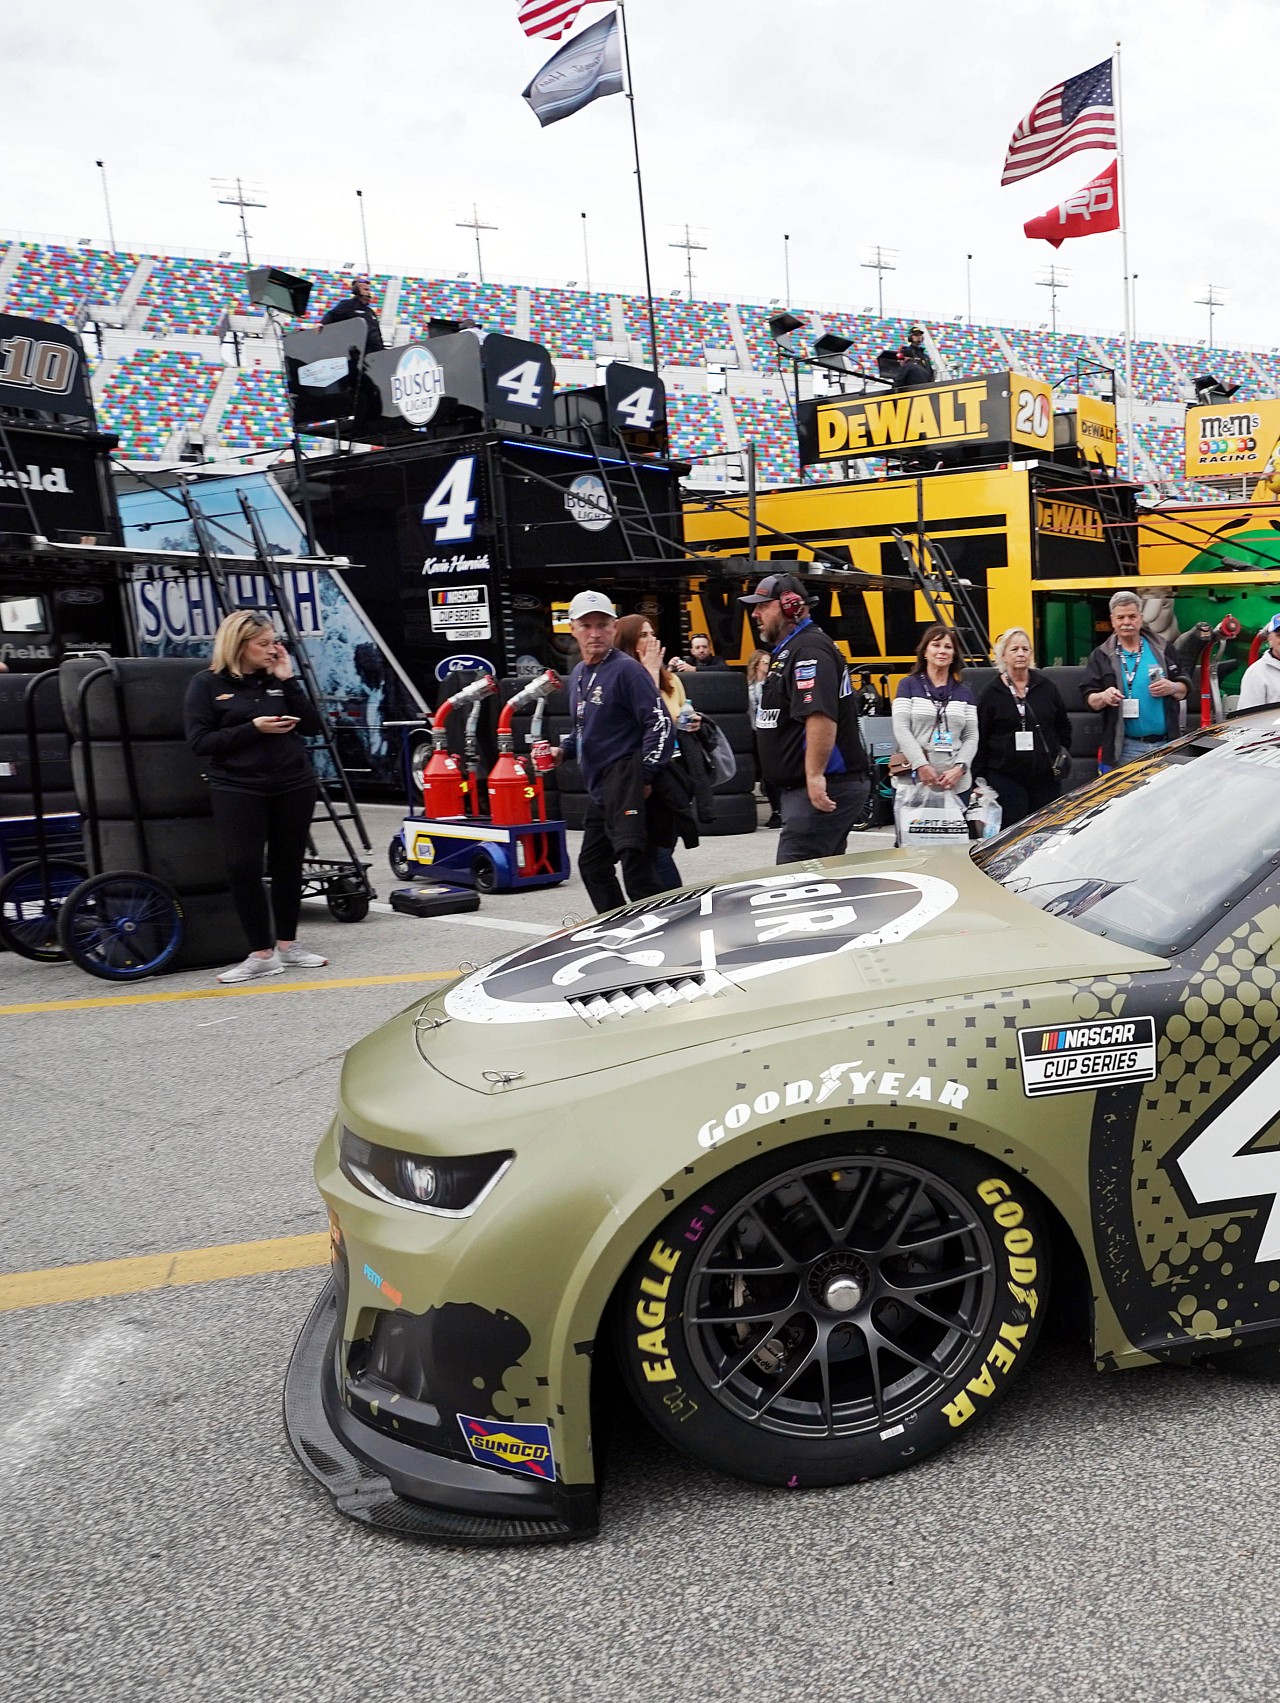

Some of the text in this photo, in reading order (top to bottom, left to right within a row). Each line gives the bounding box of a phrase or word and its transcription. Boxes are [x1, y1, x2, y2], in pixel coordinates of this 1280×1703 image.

[0, 336, 79, 395] 10
[393, 367, 445, 402] BUSCH
[497, 360, 542, 408] 4
[405, 396, 434, 413] LIGHT
[617, 387, 654, 429] 4
[1016, 390, 1049, 438] 20
[1200, 453, 1258, 464] RACING
[422, 456, 479, 543] 4
[459, 781, 469, 793] 1
[523, 786, 536, 798] 3
[1064, 1023, 1136, 1049] NASCAR
[1043, 1051, 1138, 1079] CUP SERIES
[636, 1239, 682, 1382] EAGLE
[473, 1436, 546, 1459] SUNOCO
